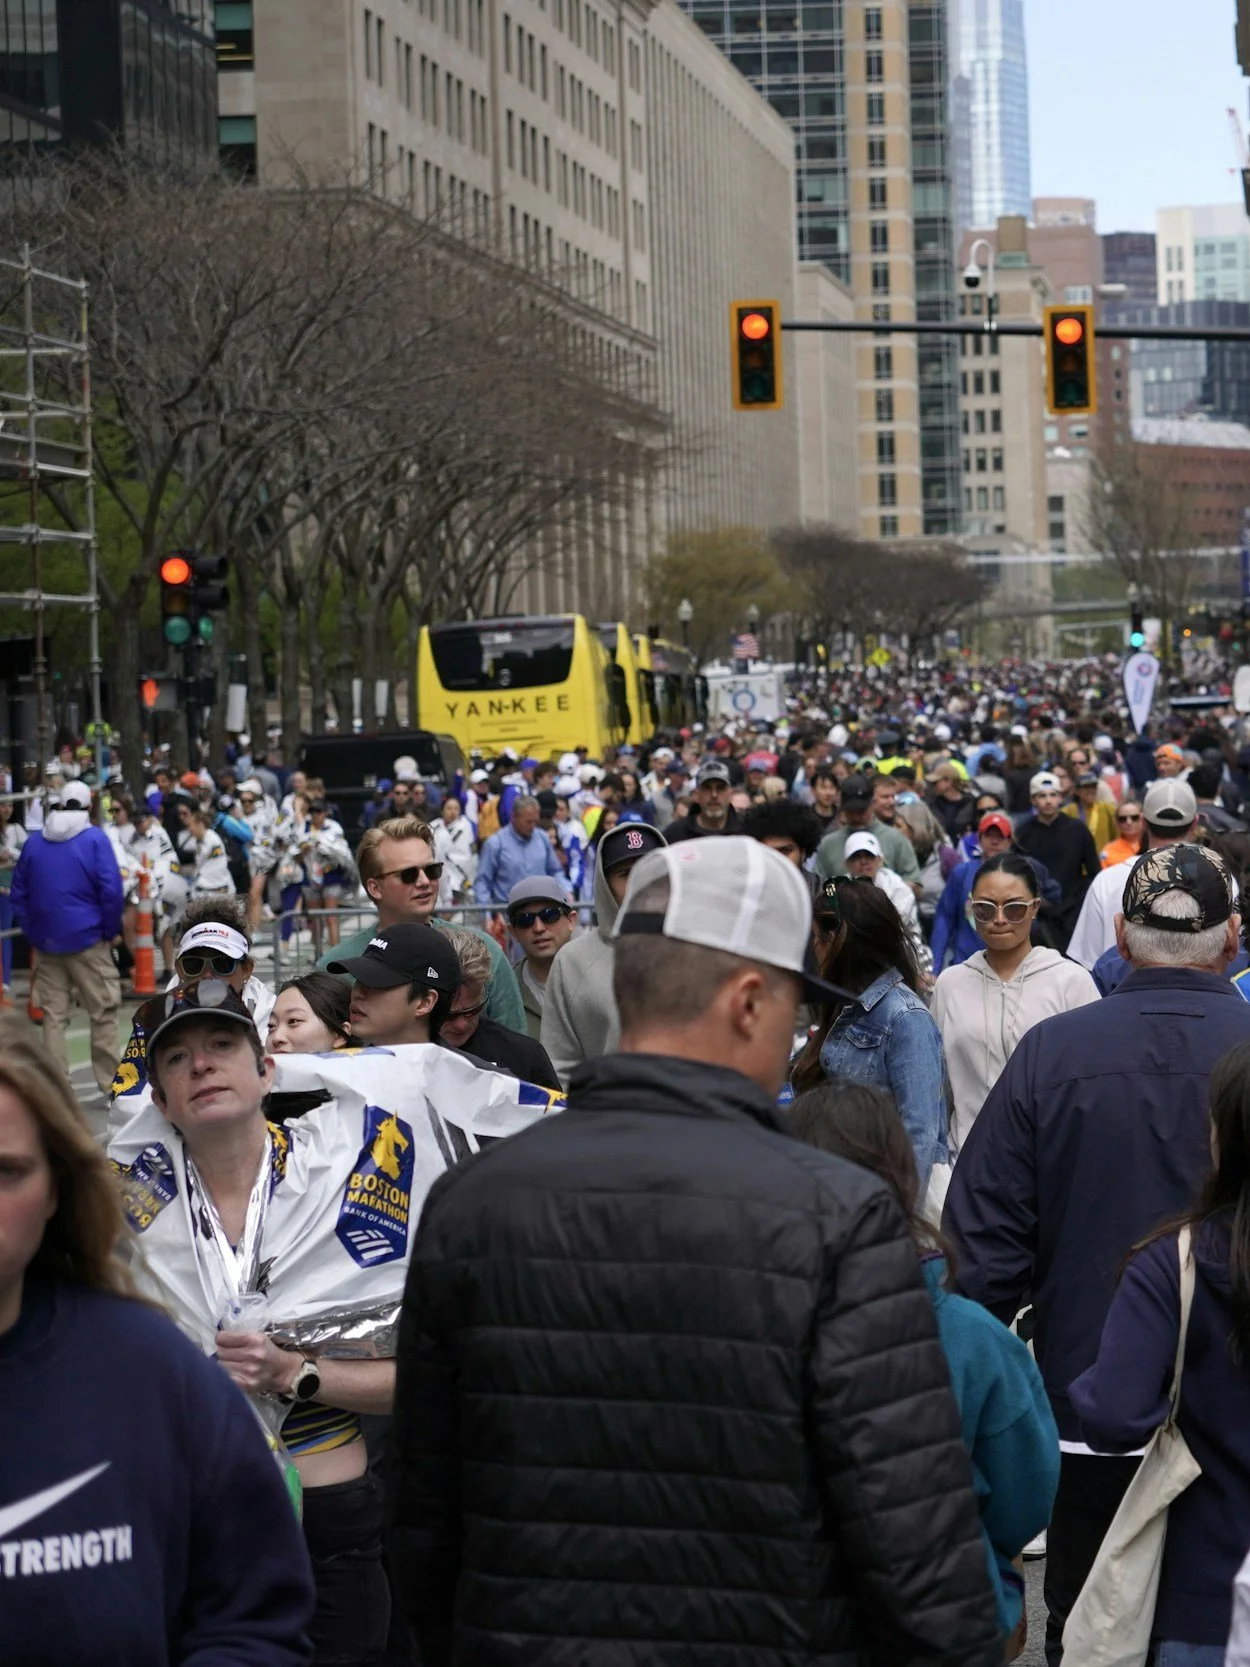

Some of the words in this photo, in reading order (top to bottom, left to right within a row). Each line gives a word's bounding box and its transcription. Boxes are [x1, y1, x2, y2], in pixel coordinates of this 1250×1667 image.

[346, 1190, 408, 1224] MARATHON
[349, 1172, 409, 1210] BOSTON
[343, 1206, 367, 1219] BANK
[367, 1213, 380, 1222] OF
[378, 1218, 407, 1236] AMERICA
[0, 1525, 132, 1578] TRENGTH
